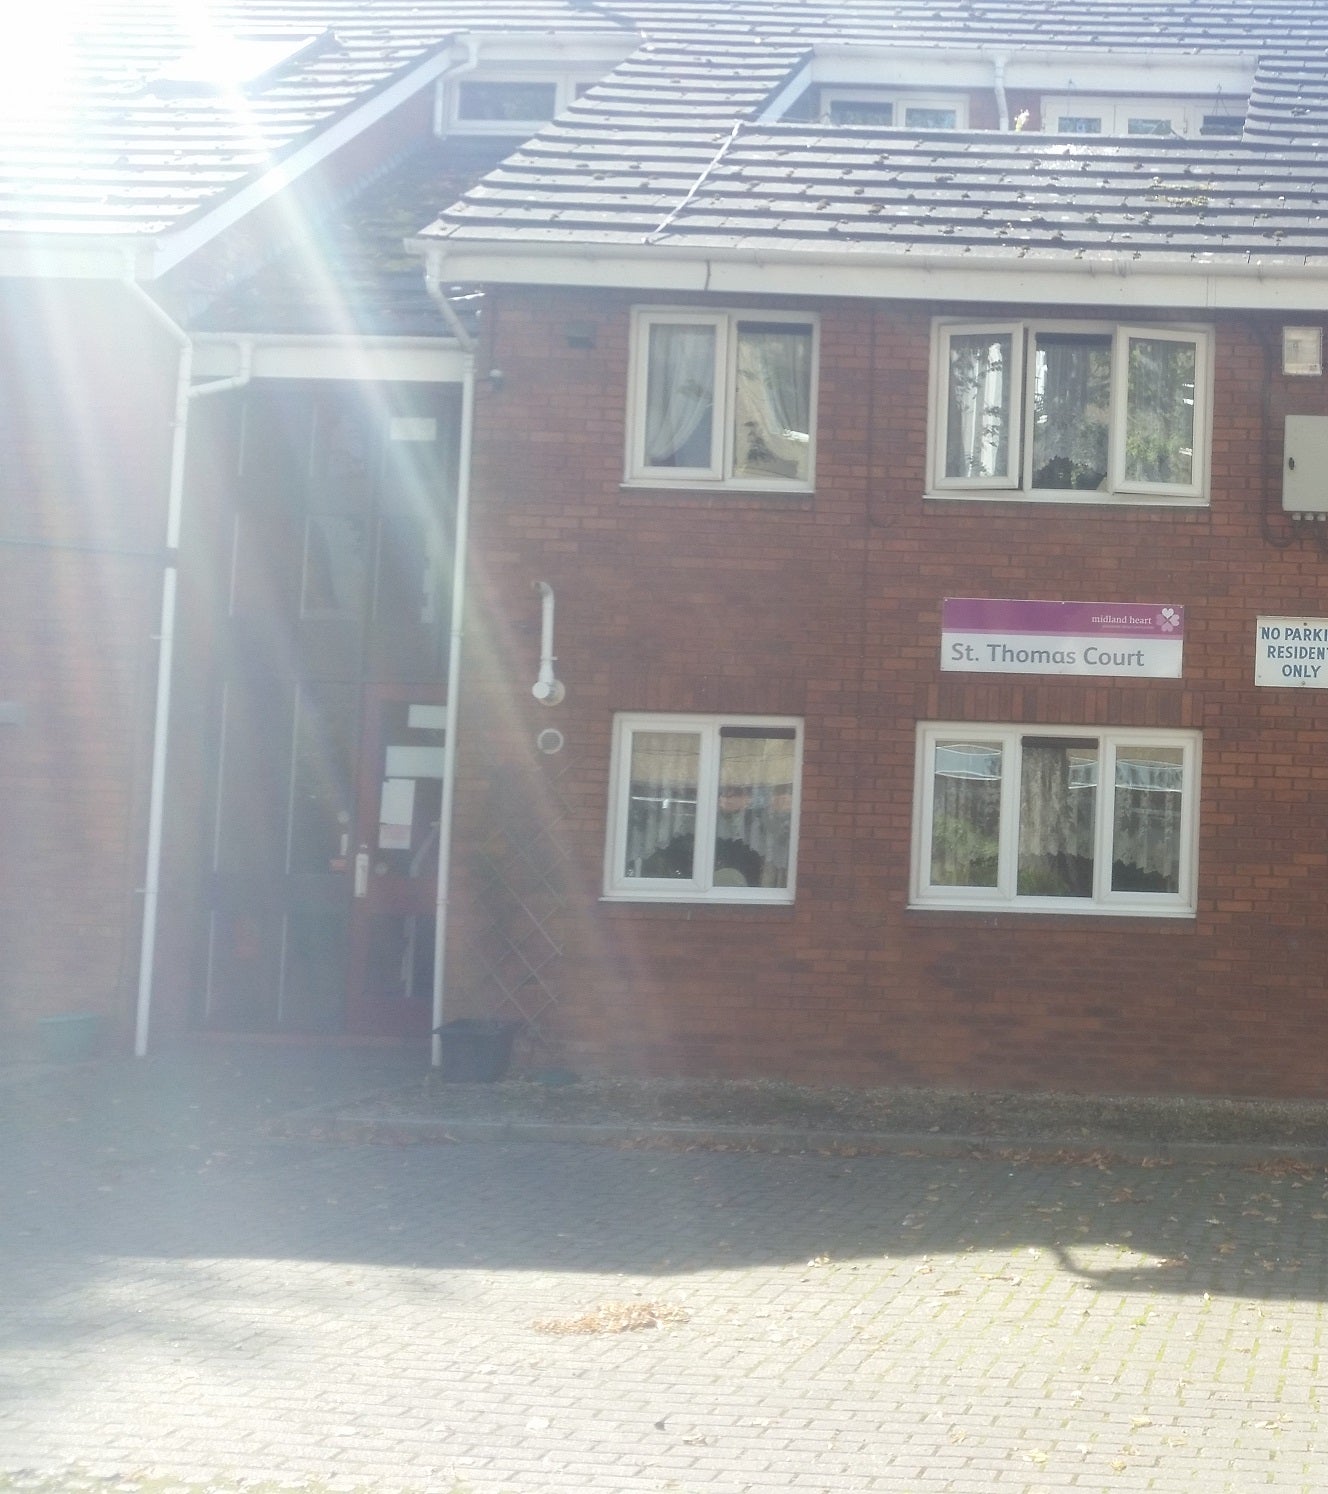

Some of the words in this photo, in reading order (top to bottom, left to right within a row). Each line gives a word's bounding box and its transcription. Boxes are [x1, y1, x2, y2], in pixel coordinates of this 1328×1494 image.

[1091, 615, 1127, 624] midland
[1129, 615, 1152, 625] heart
[1261, 627, 1281, 640] NO
[951, 643, 980, 661] St.
[987, 644, 1077, 665] Thomas
[1083, 647, 1145, 667] Court
[1281, 664, 1322, 678] ONLY
